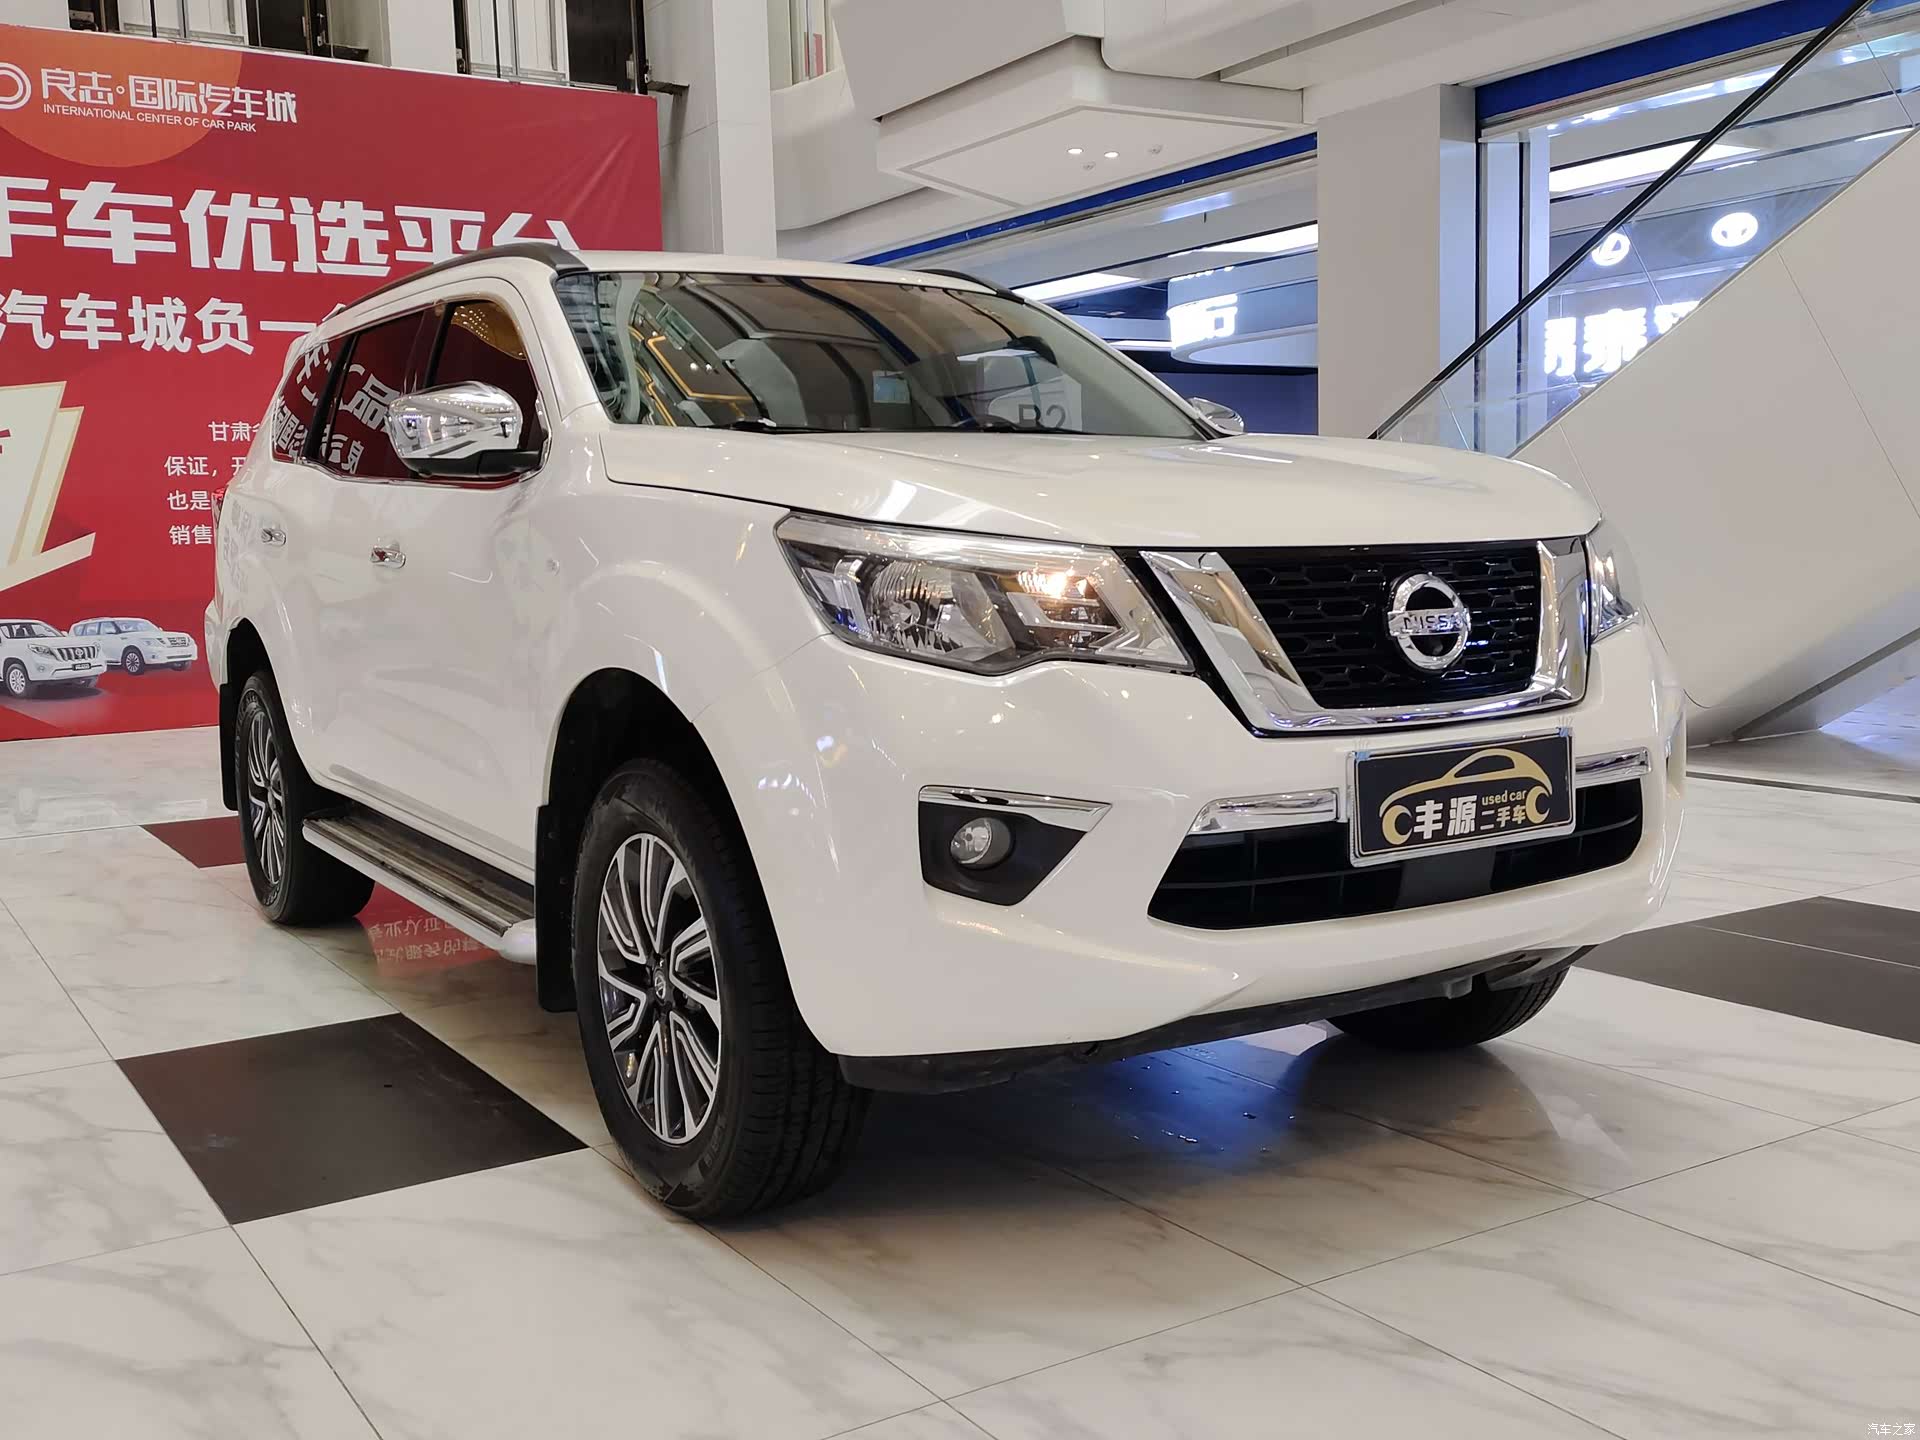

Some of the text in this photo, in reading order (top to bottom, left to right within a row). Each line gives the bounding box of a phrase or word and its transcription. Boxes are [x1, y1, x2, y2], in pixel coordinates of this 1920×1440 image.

[43, 103, 257, 132] INTERNATIONAL CENTER OF CAR PARK
[0, 289, 347, 355] 汽车城负一
[167, 490, 212, 511] 也是
[169, 524, 213, 545] 销售
[1481, 790, 1527, 806] used car
[1413, 795, 1478, 840] 丰源
[1480, 804, 1527, 831] 二手车
